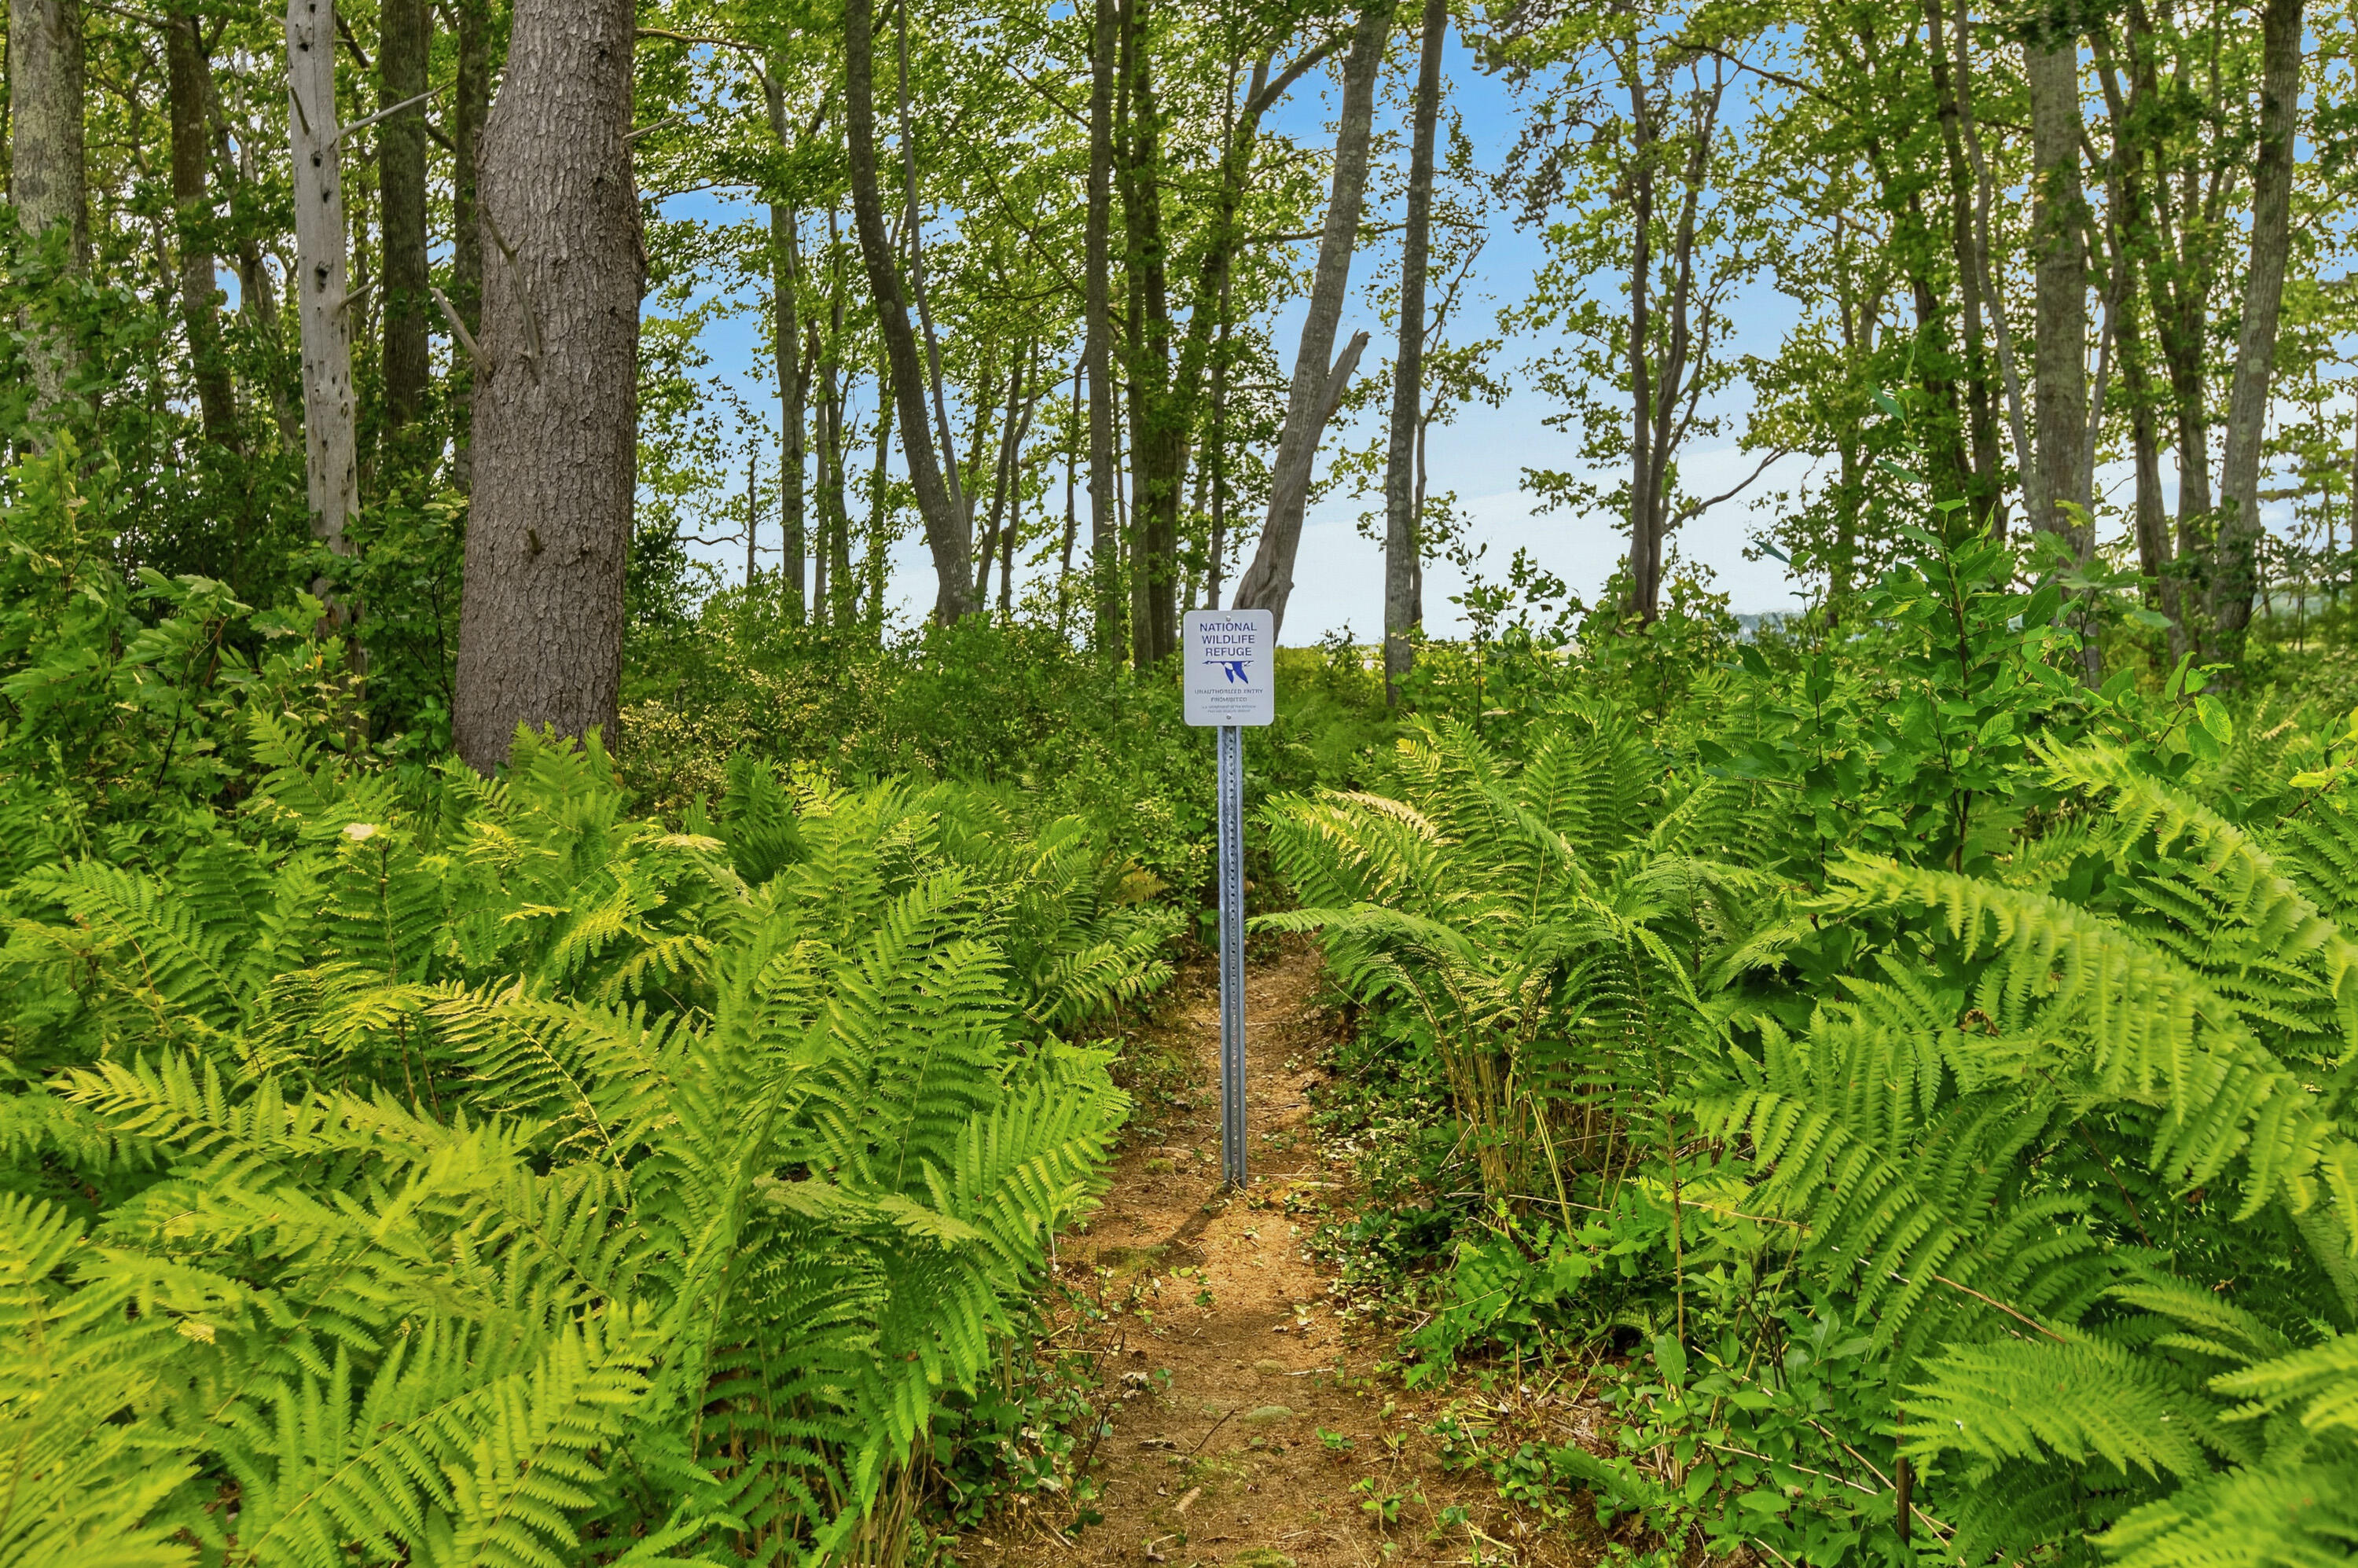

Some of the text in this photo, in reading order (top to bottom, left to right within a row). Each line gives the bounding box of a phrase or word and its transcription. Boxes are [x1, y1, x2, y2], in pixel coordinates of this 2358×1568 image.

[1199, 622, 1258, 632] NATIONAL
[1202, 634, 1255, 644] WILDLIFE
[1206, 647, 1252, 657] REFUGE
